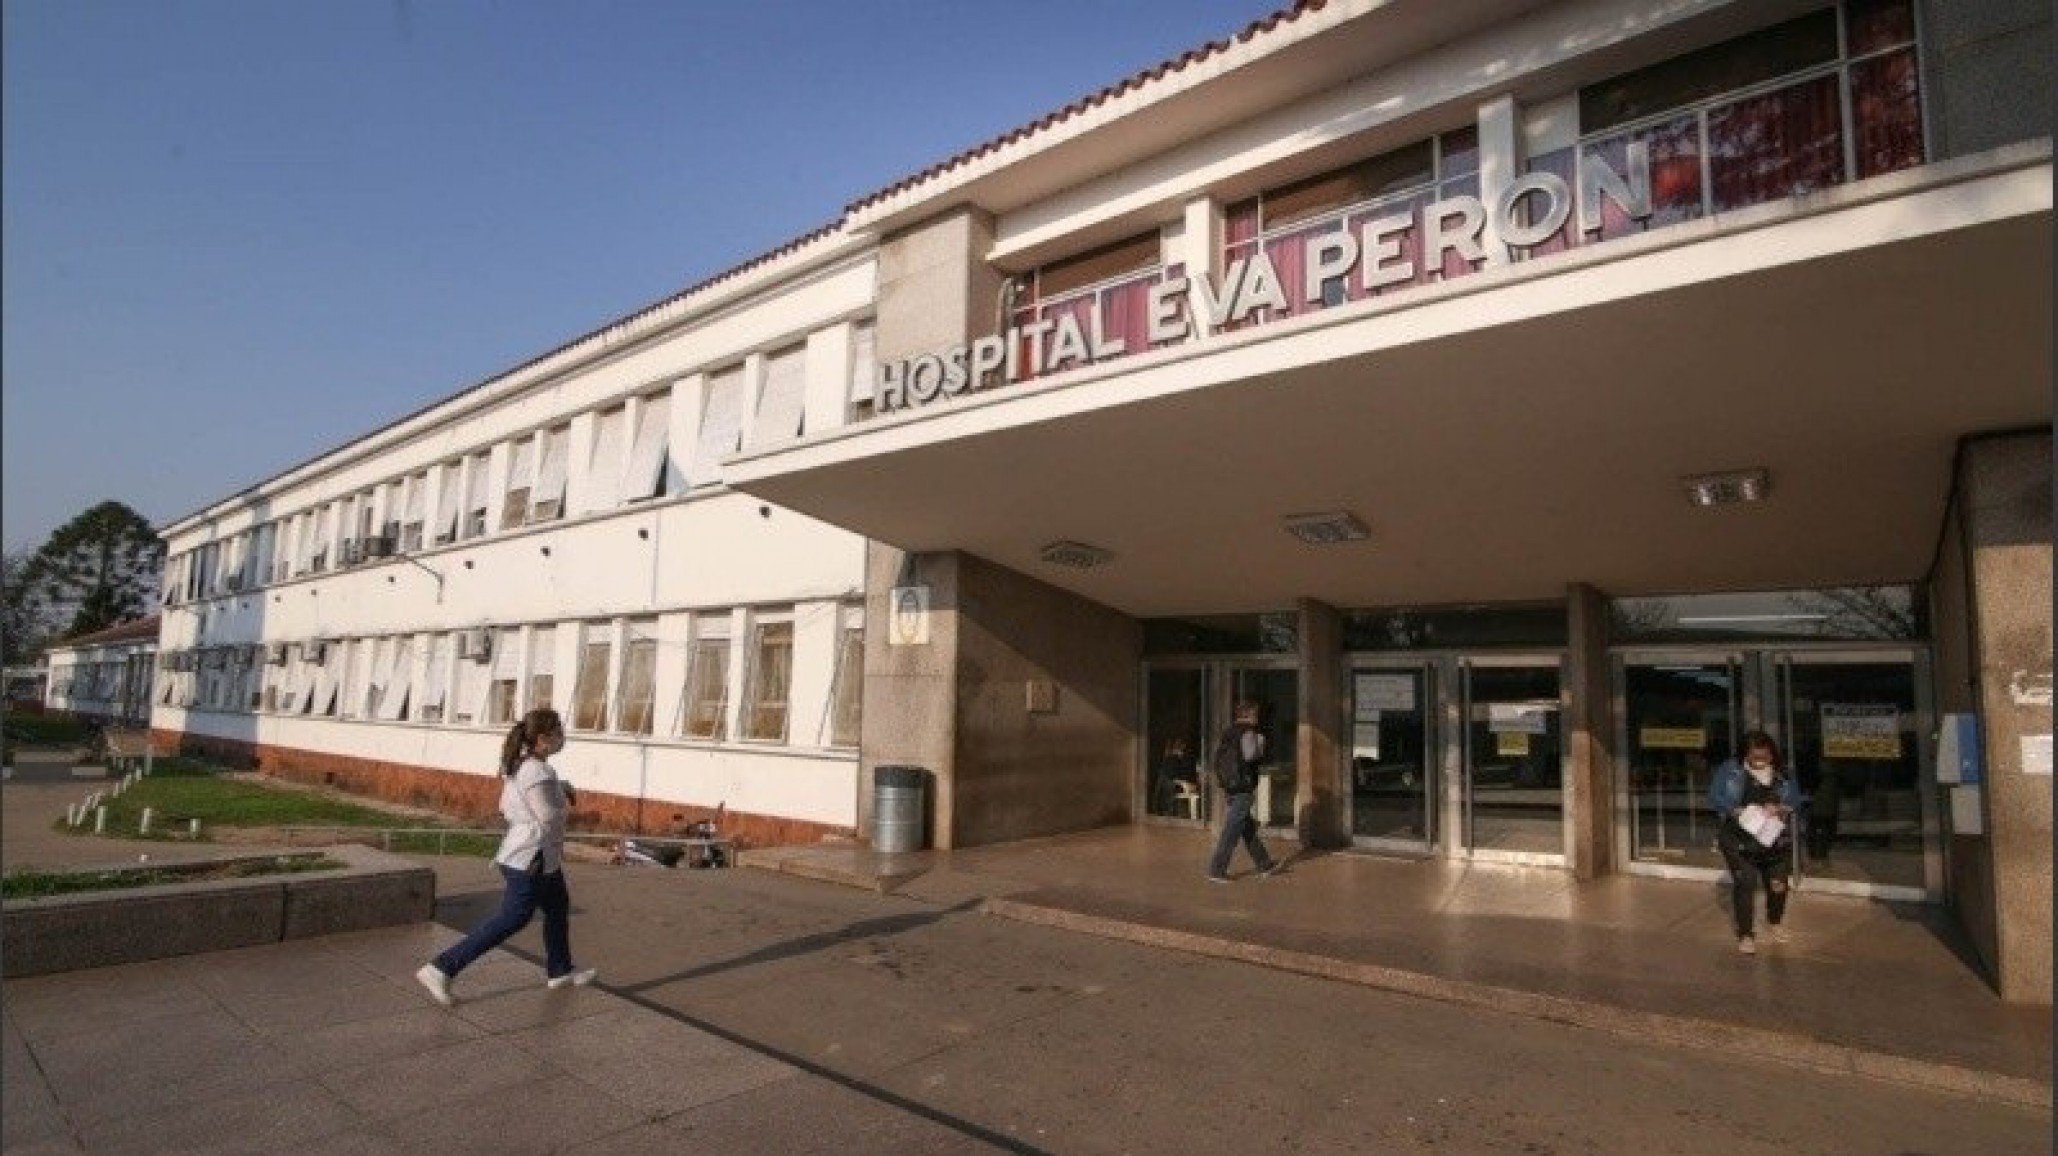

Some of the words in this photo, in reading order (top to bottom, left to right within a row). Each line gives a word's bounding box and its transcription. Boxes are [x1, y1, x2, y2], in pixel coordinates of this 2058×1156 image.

[875, 303, 1125, 411] HOSPITAL
[1147, 254, 1287, 341] EVA
[1306, 141, 1650, 301] PERON
